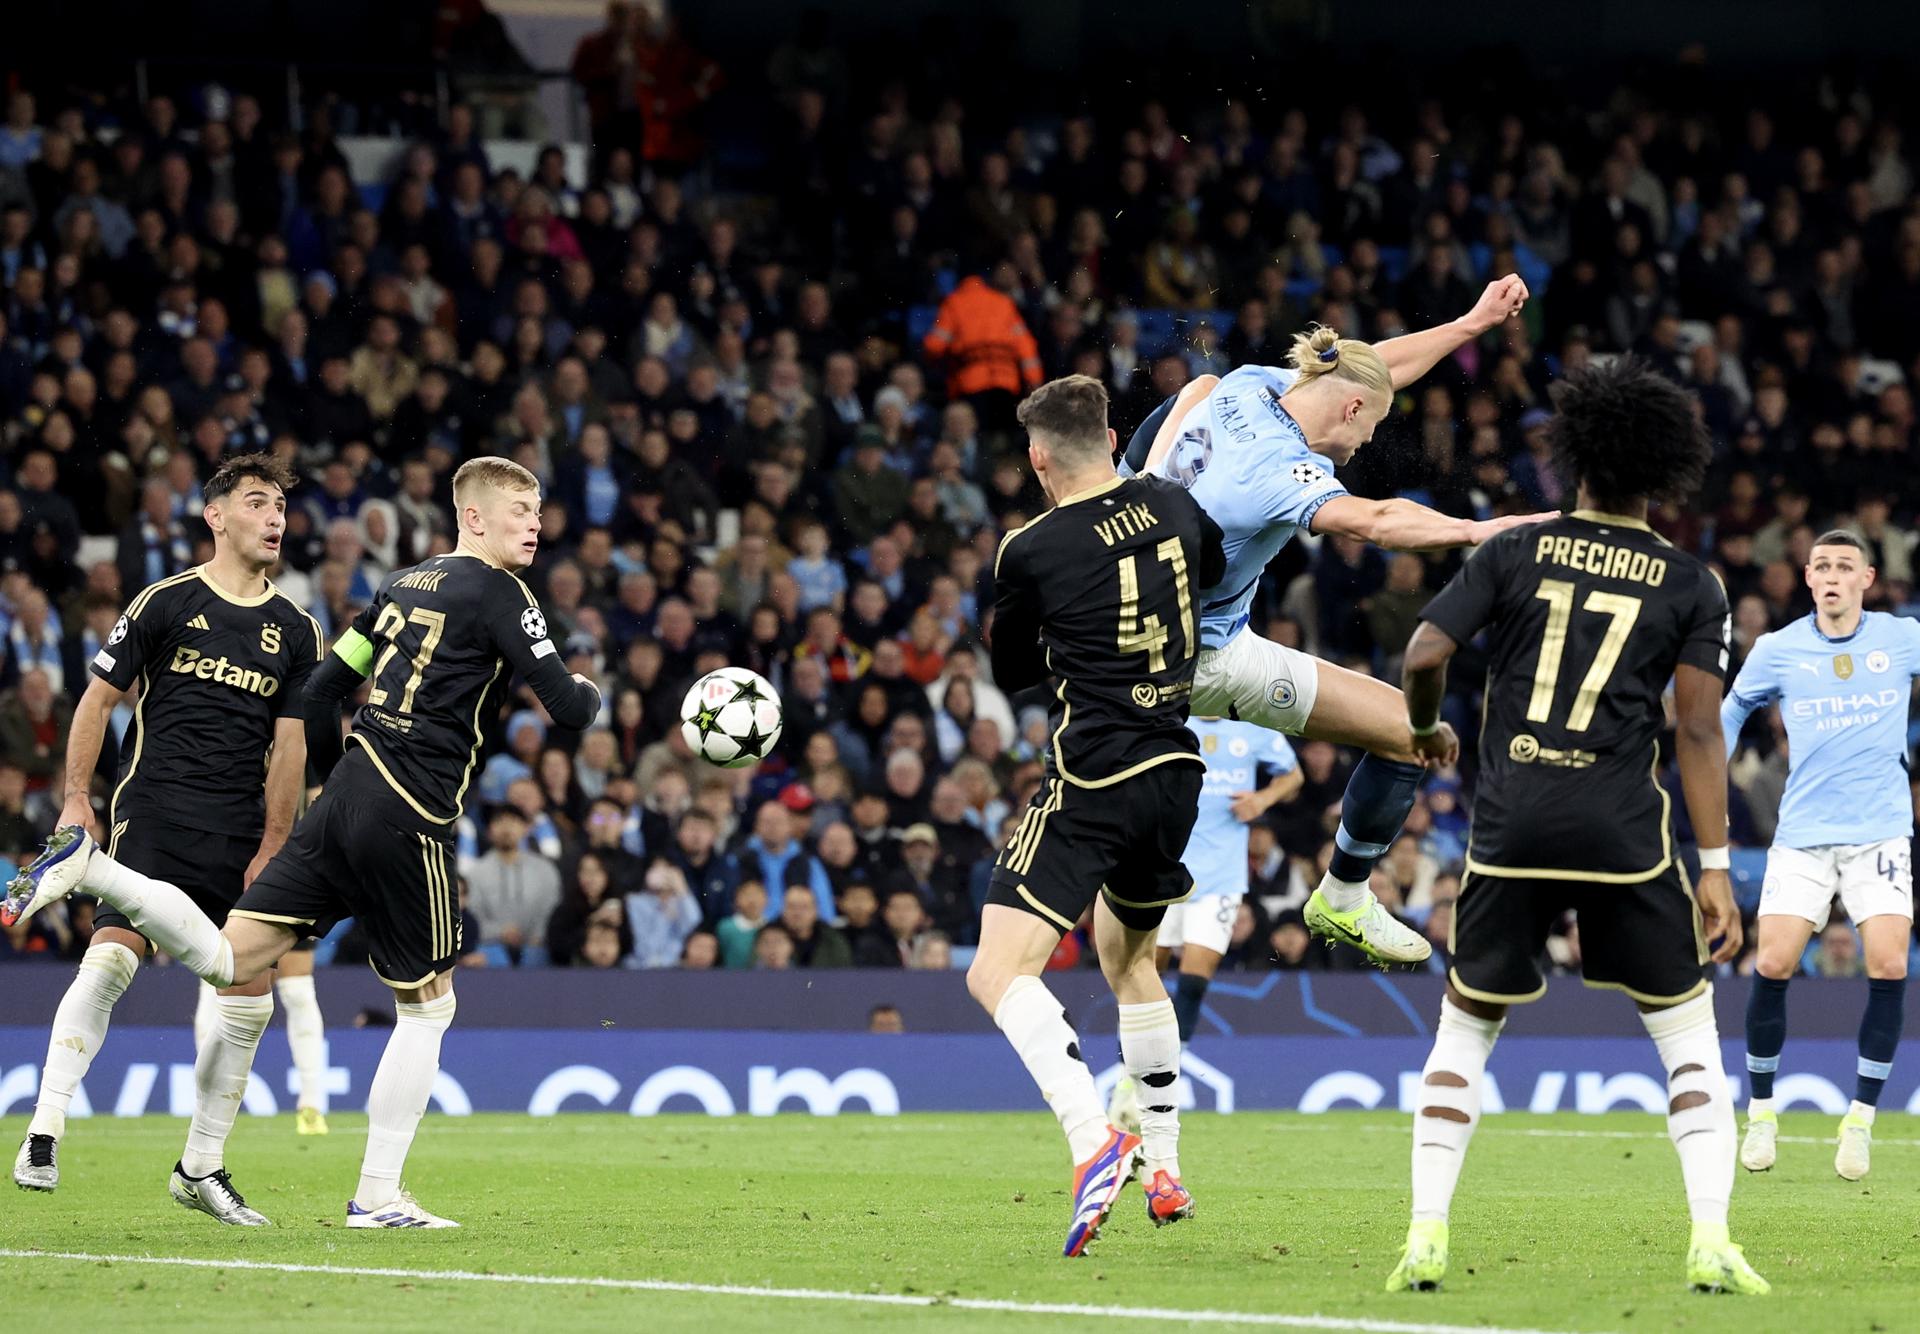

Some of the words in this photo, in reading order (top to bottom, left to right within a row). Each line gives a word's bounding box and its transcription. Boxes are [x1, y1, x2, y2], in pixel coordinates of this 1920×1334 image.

[1093, 502, 1159, 547] VITÍK
[1535, 535, 1667, 587] PRECIADO
[1117, 535, 1195, 674] 41
[169, 646, 279, 697] Betano
[367, 601, 447, 714] 27
[1526, 578, 1643, 732] 17
[1793, 688, 1899, 716] ETIHAD
[1815, 711, 1880, 732] AIRWAYS
[1216, 895, 1231, 923] 8
